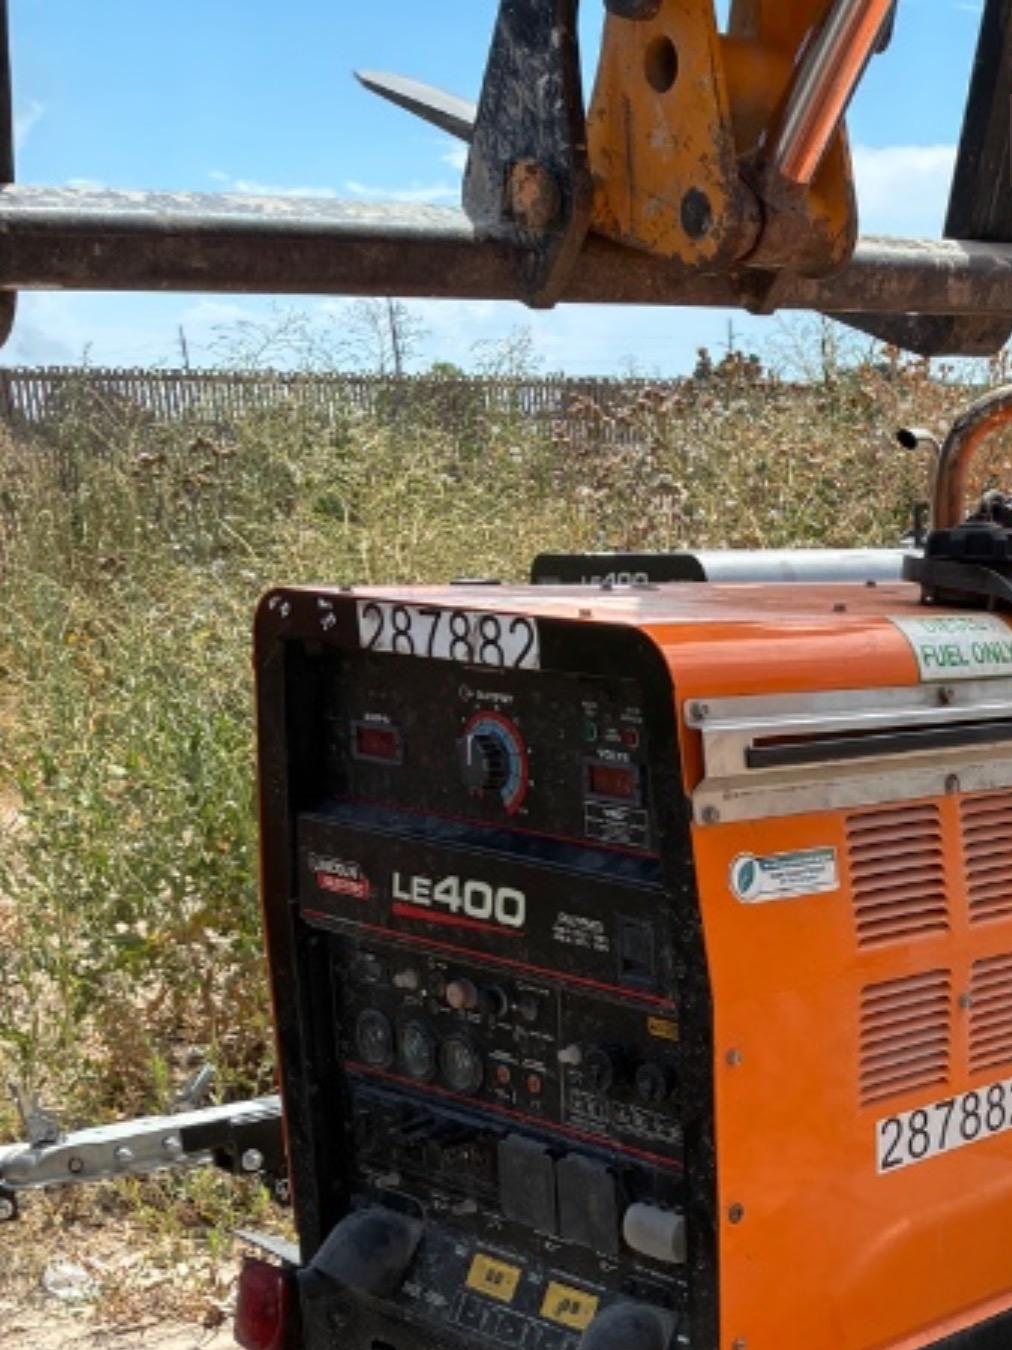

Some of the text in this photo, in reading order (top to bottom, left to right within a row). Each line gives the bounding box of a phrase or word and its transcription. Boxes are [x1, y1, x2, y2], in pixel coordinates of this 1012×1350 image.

[362, 603, 536, 670] 287882
[920, 643, 969, 667] FUEL
[391, 871, 527, 928] LE400
